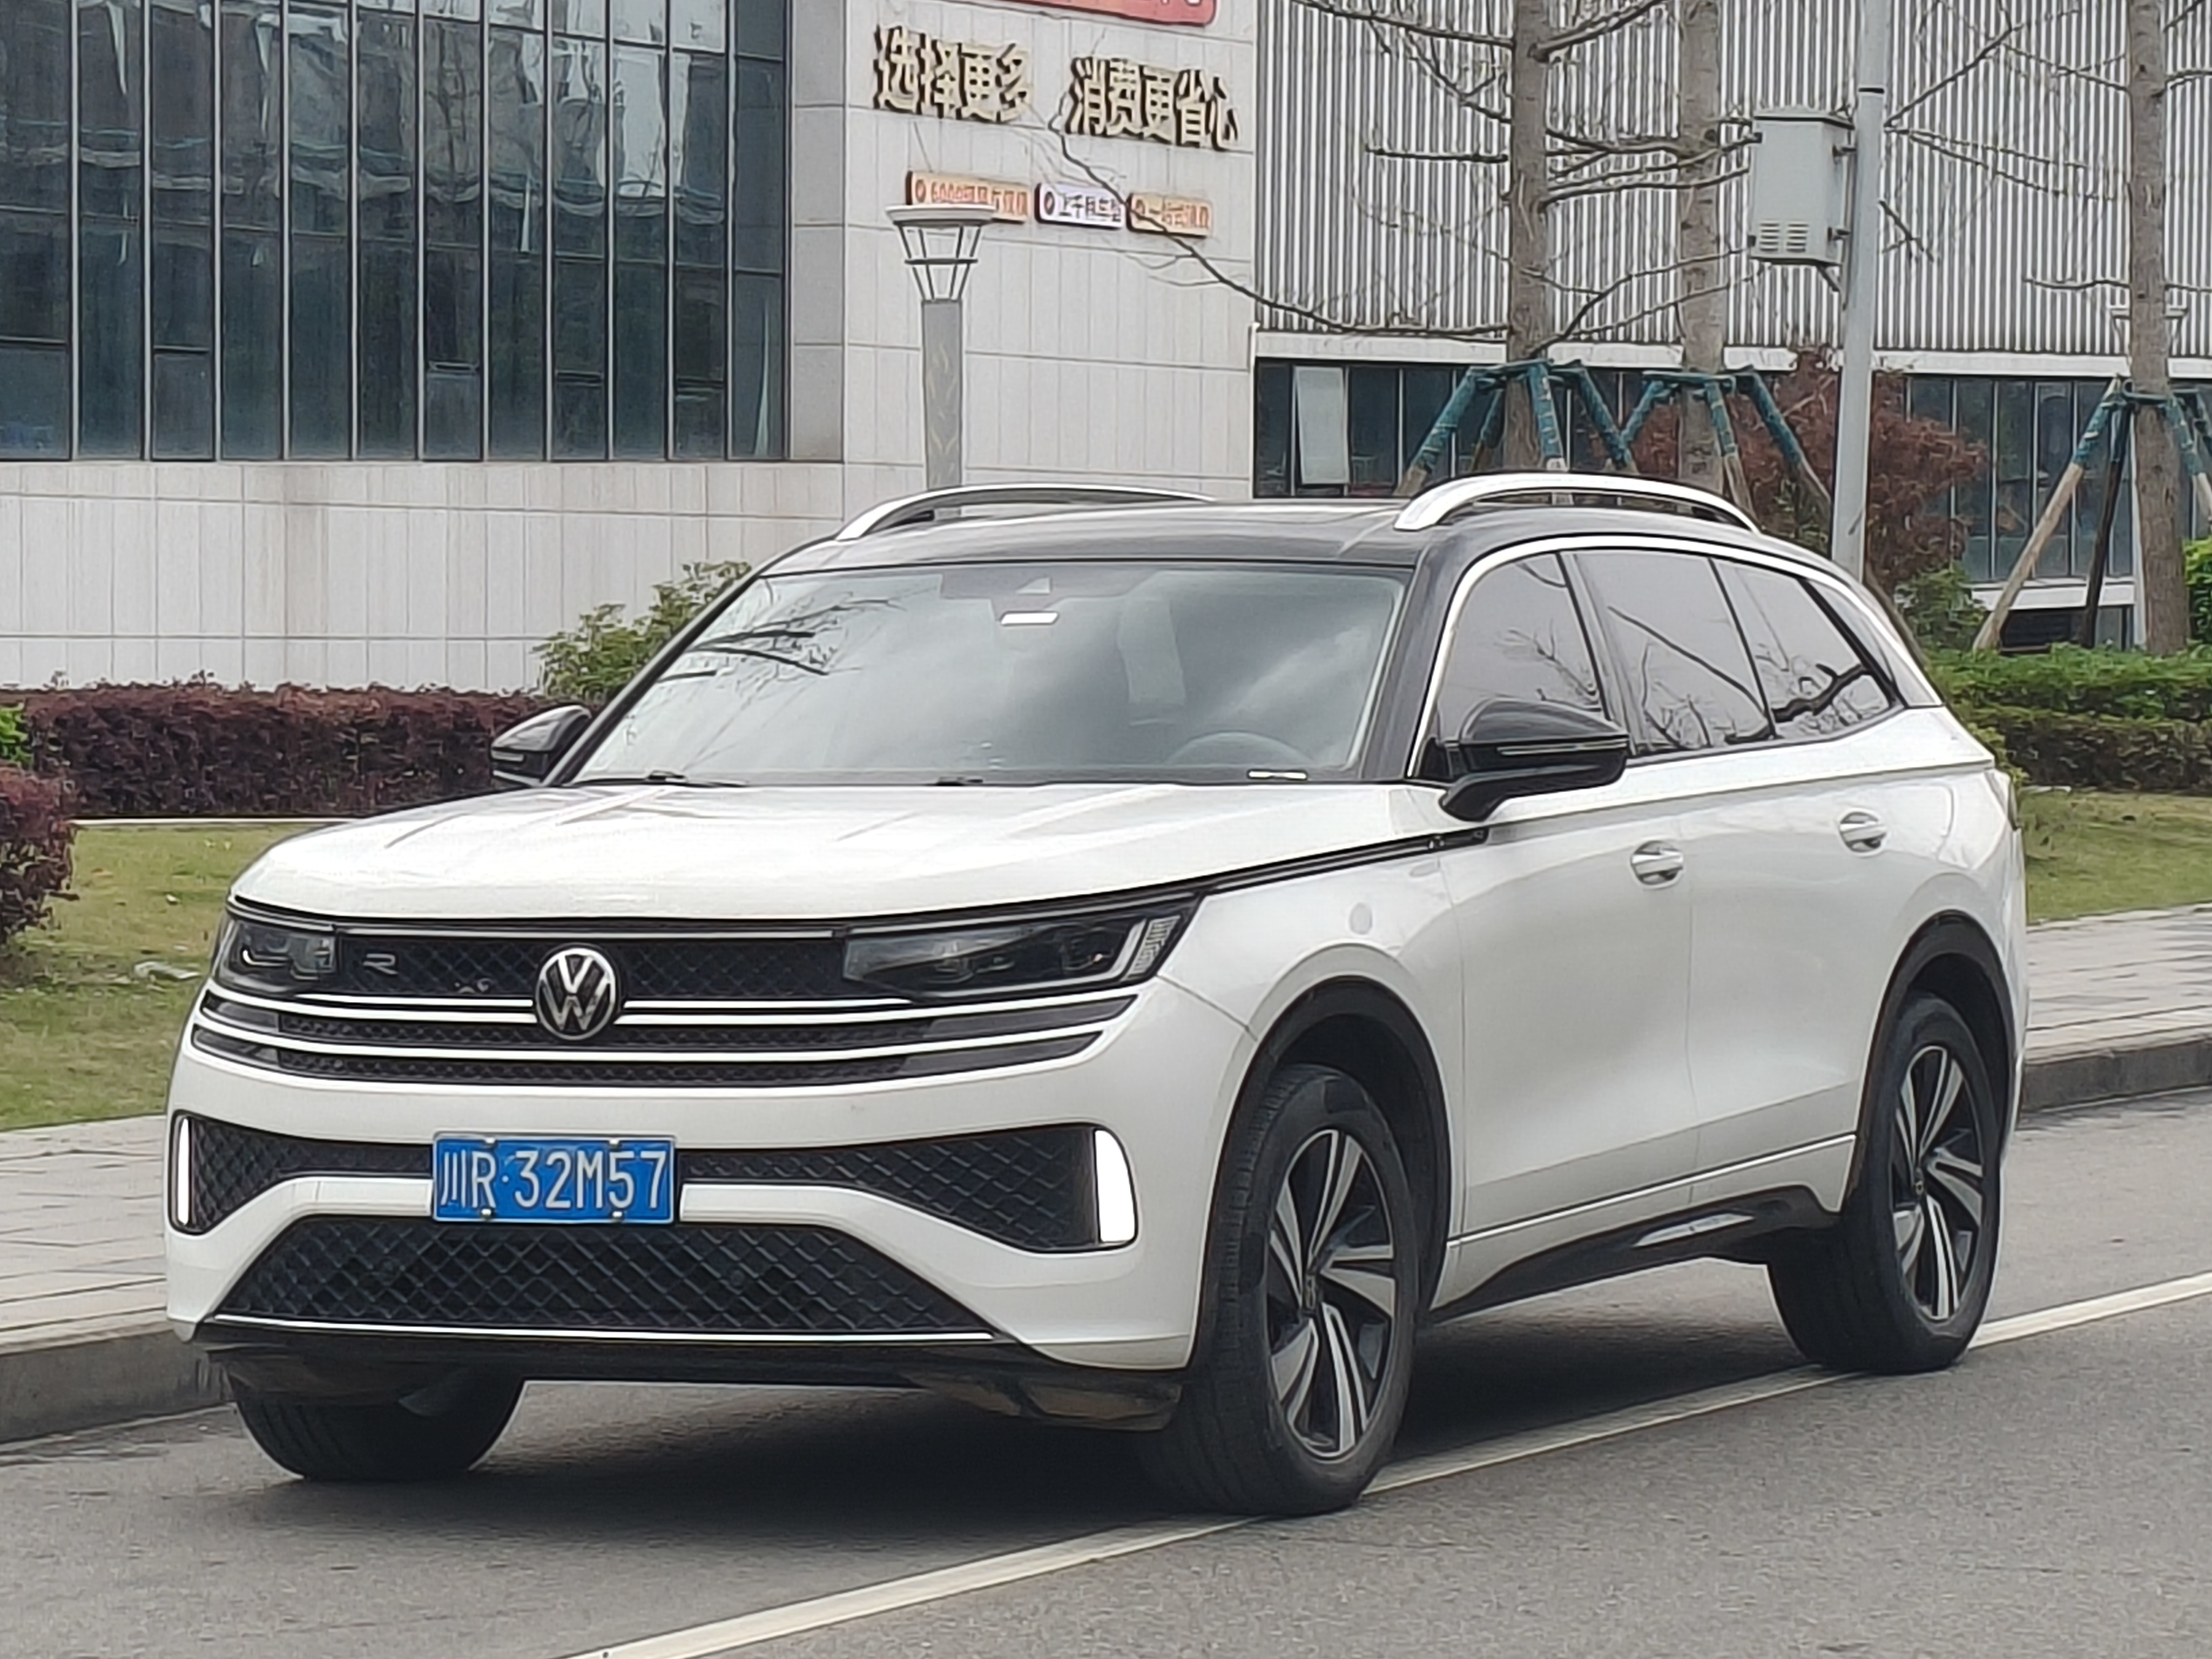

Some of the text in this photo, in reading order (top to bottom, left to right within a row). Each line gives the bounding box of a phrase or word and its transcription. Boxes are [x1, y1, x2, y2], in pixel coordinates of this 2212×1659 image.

[873, 24, 1239, 151] 选择更多 消费更省心
